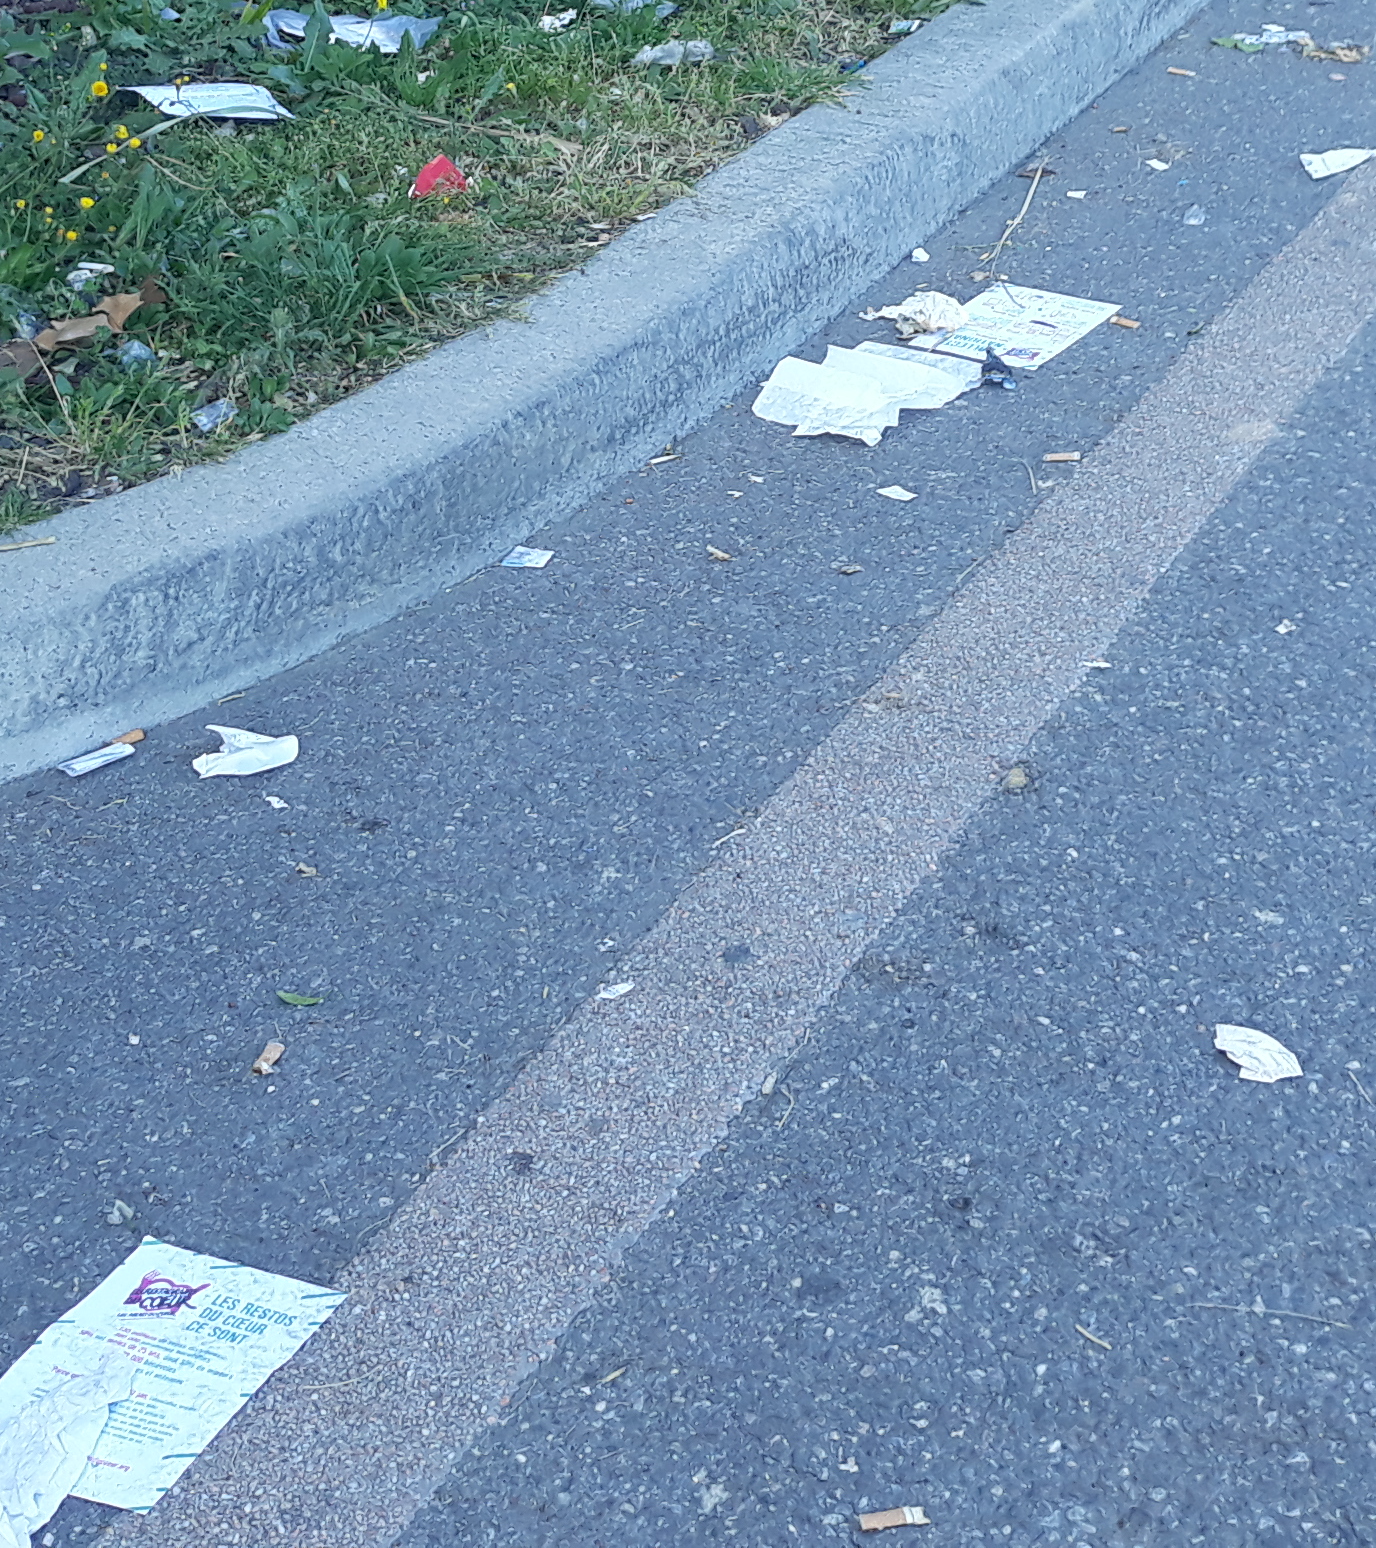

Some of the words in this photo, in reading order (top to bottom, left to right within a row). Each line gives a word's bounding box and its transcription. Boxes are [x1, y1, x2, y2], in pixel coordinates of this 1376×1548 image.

[198, 1307, 223, 1322] DU
[222, 1314, 269, 1335] CŒUR
[211, 1294, 241, 1311] LES
[240, 1301, 298, 1327] RESTOS
[185, 1320, 209, 1334] CE
[208, 1326, 250, 1345] SONT
